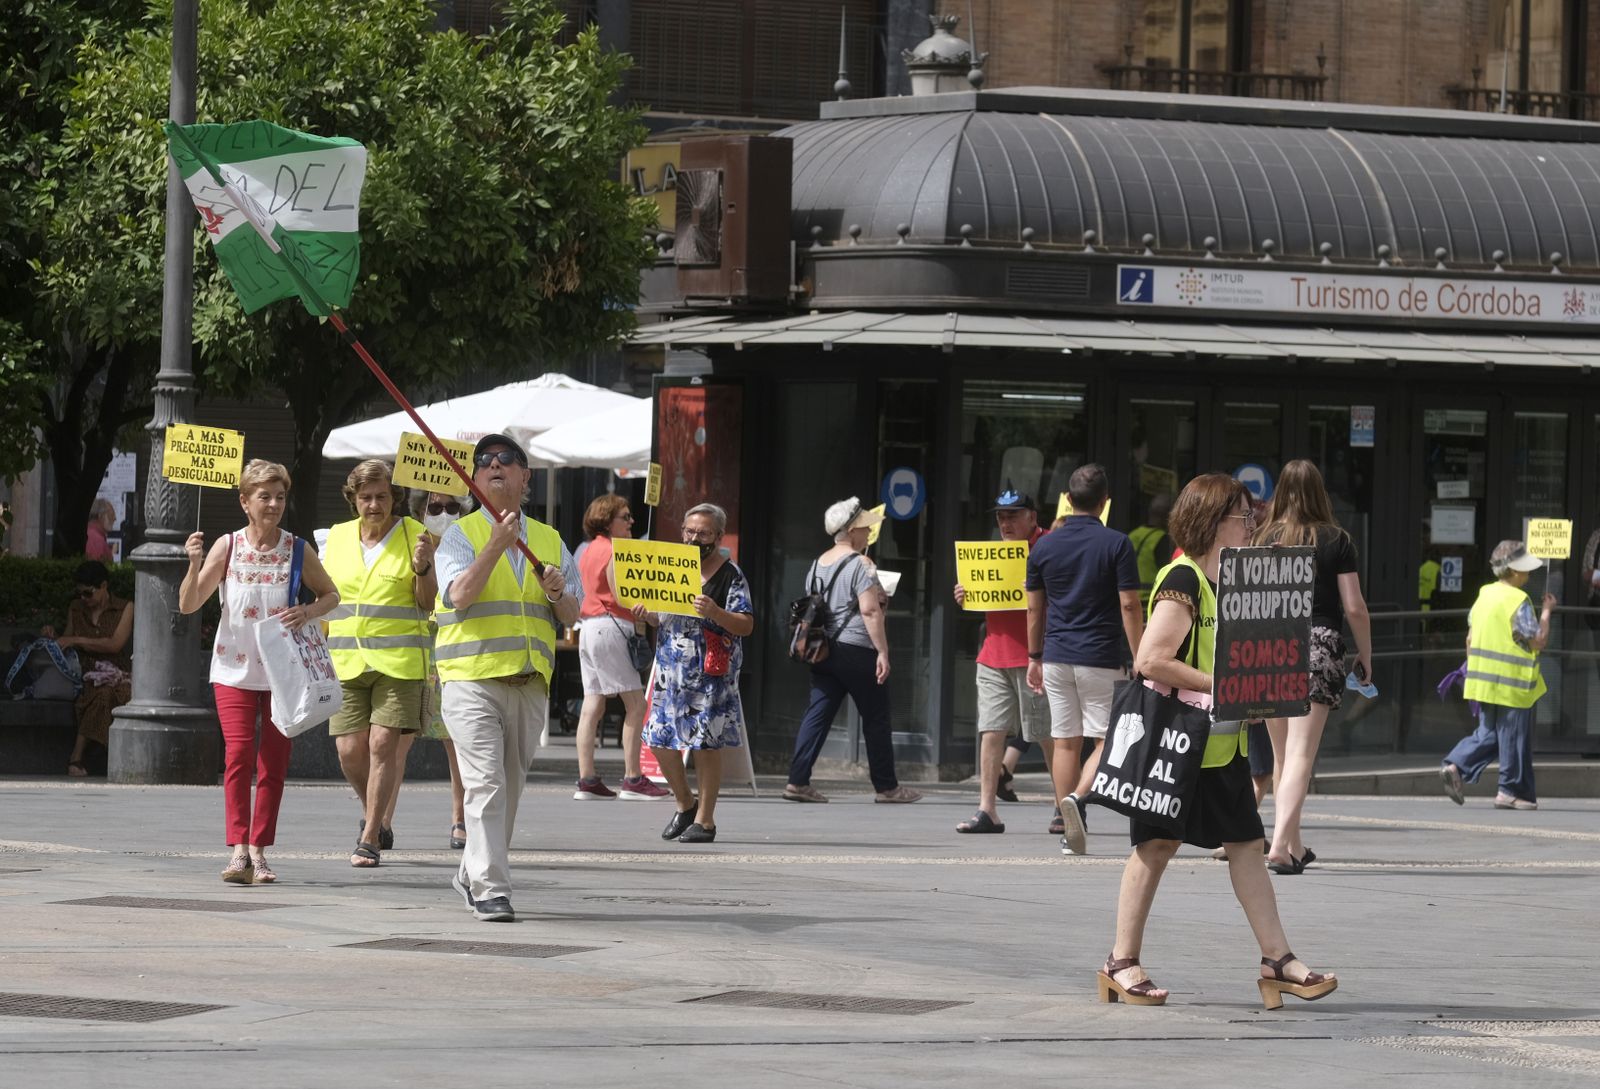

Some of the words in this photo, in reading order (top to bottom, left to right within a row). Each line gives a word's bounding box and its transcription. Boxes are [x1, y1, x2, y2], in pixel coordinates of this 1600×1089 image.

[269, 163, 354, 214] DEL
[1210, 273, 1244, 284] IMTUR
[1290, 277, 1390, 311] Turismo
[1398, 282, 1428, 313] de
[1437, 283, 1541, 316] Córdoba
[186, 428, 194, 441] A
[200, 430, 225, 444] MAS
[170, 440, 238, 459] PRECARIEDAD
[406, 441, 426, 453] SIN
[190, 455, 215, 469] MAS
[402, 454, 426, 467] POR
[168, 465, 236, 485] DESIGUALDAD
[413, 471, 427, 482] LA
[430, 474, 452, 486] LUZ
[1537, 522, 1563, 530] CALLAR
[614, 551, 642, 563] MÁS
[646, 554, 654, 564] Y
[658, 556, 698, 569] MEJOR
[958, 547, 1025, 560] ENVEJECER
[625, 568, 675, 584] AYUDA
[680, 574, 690, 586] A
[971, 569, 984, 581] EN
[987, 569, 1003, 581] EL
[1222, 557, 1236, 586] SI
[1242, 556, 1313, 585] VOTAMOS
[964, 589, 1023, 602] ENTORNO
[1221, 590, 1313, 621] CORRUPTOS
[1228, 639, 1301, 669] SOMOS
[1159, 727, 1191, 754] NO
[1148, 758, 1176, 785] AL
[1090, 771, 1182, 819] RACISMO
